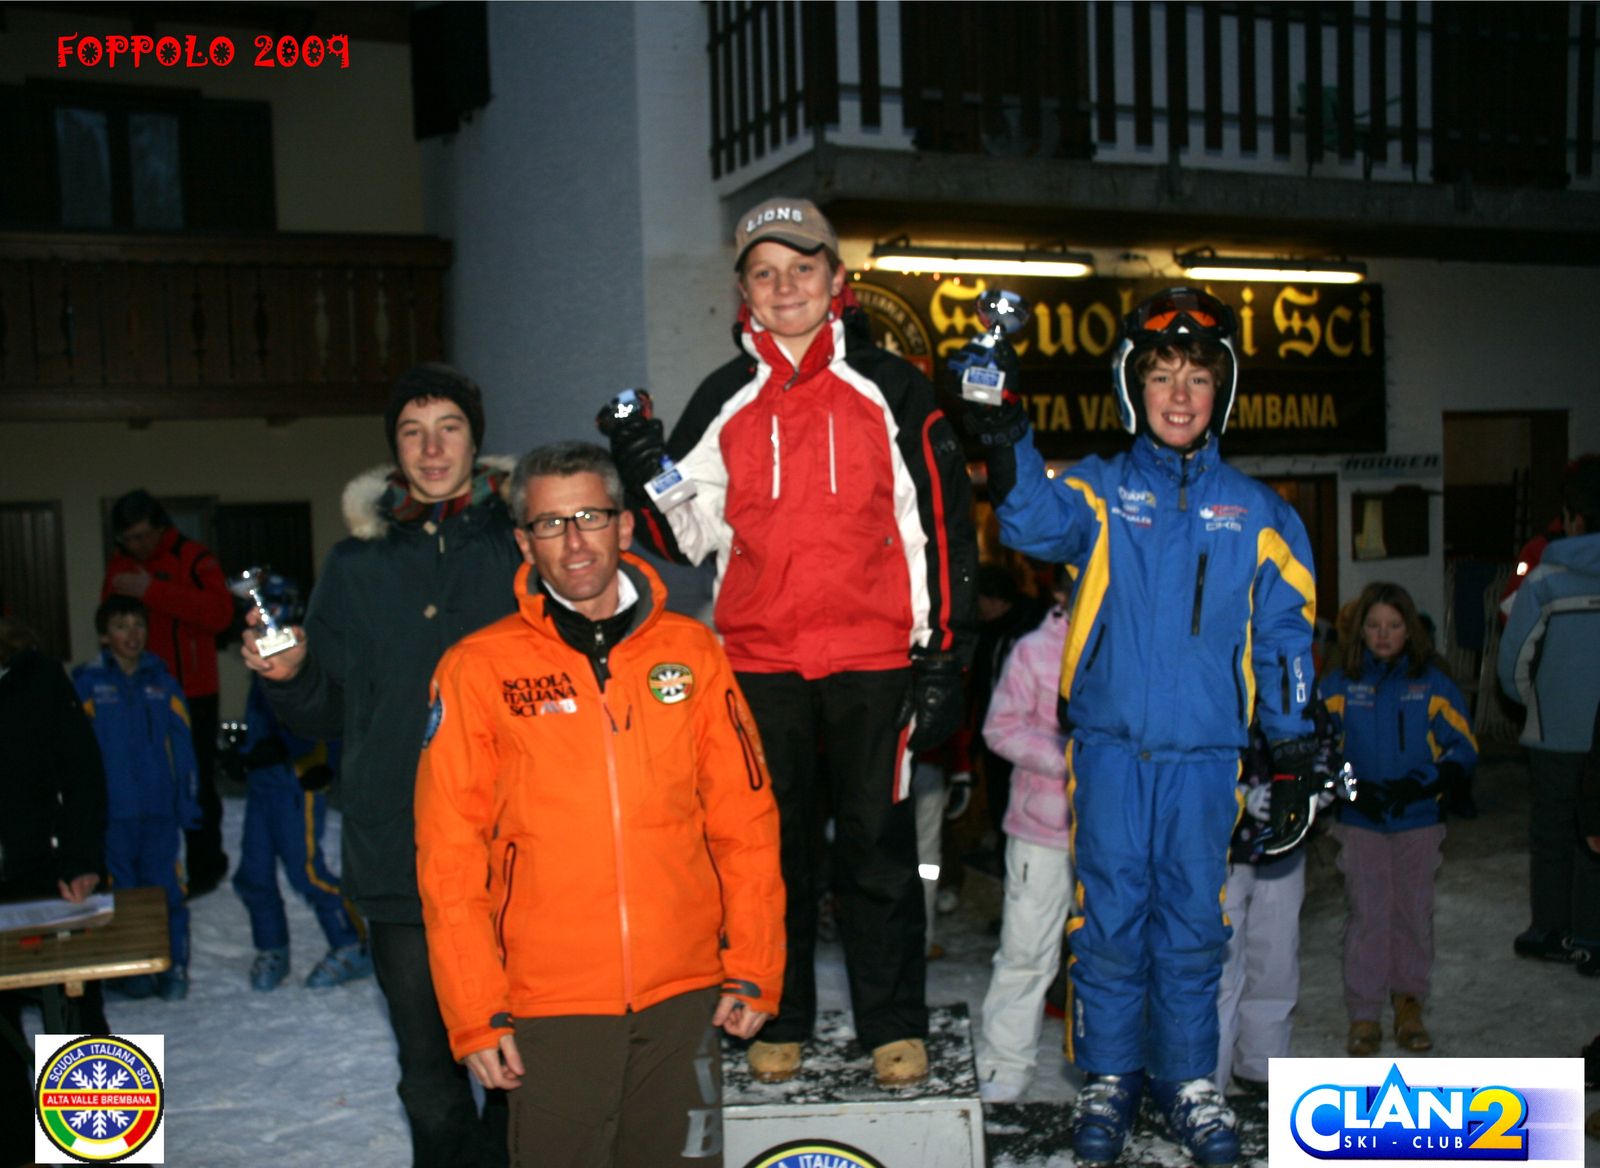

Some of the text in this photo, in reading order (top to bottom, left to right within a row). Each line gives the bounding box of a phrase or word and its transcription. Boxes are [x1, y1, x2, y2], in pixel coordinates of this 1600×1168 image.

[746, 207, 803, 233] LIONS
[1272, 286, 1374, 358] Sci
[502, 672, 572, 690] SCUOLA
[502, 685, 578, 705] ITALIANA
[510, 703, 536, 718] SCI
